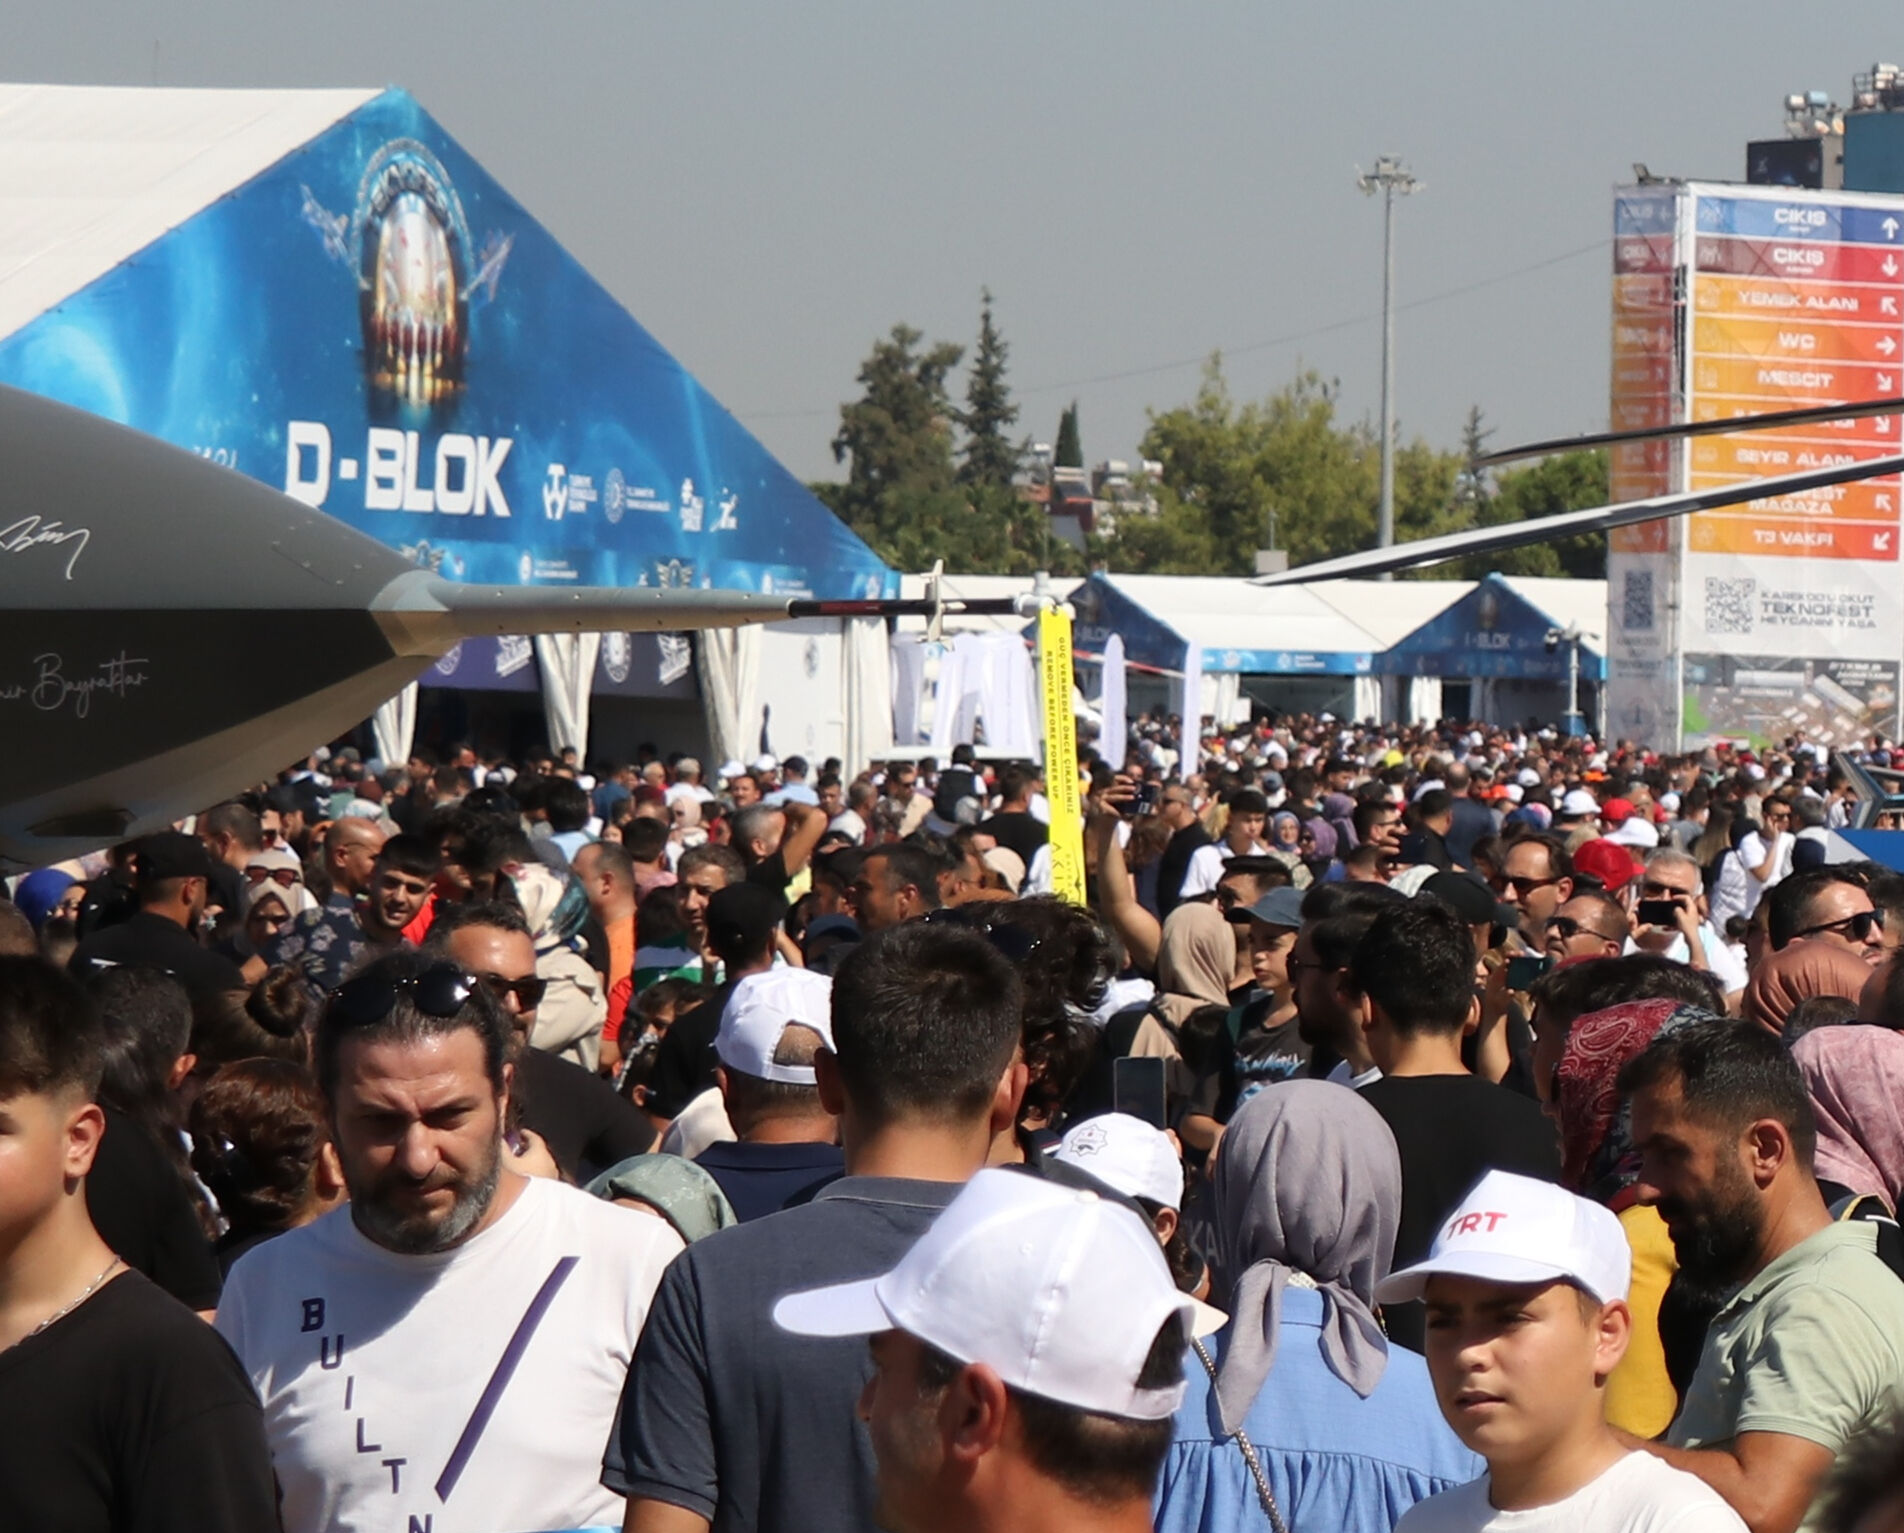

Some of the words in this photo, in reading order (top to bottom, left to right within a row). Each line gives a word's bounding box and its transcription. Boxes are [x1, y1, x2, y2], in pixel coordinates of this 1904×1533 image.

[1778, 332, 1816, 349] WC
[1760, 601, 1874, 618] TEKNOFEST
[1446, 1211, 1509, 1241] TRT
